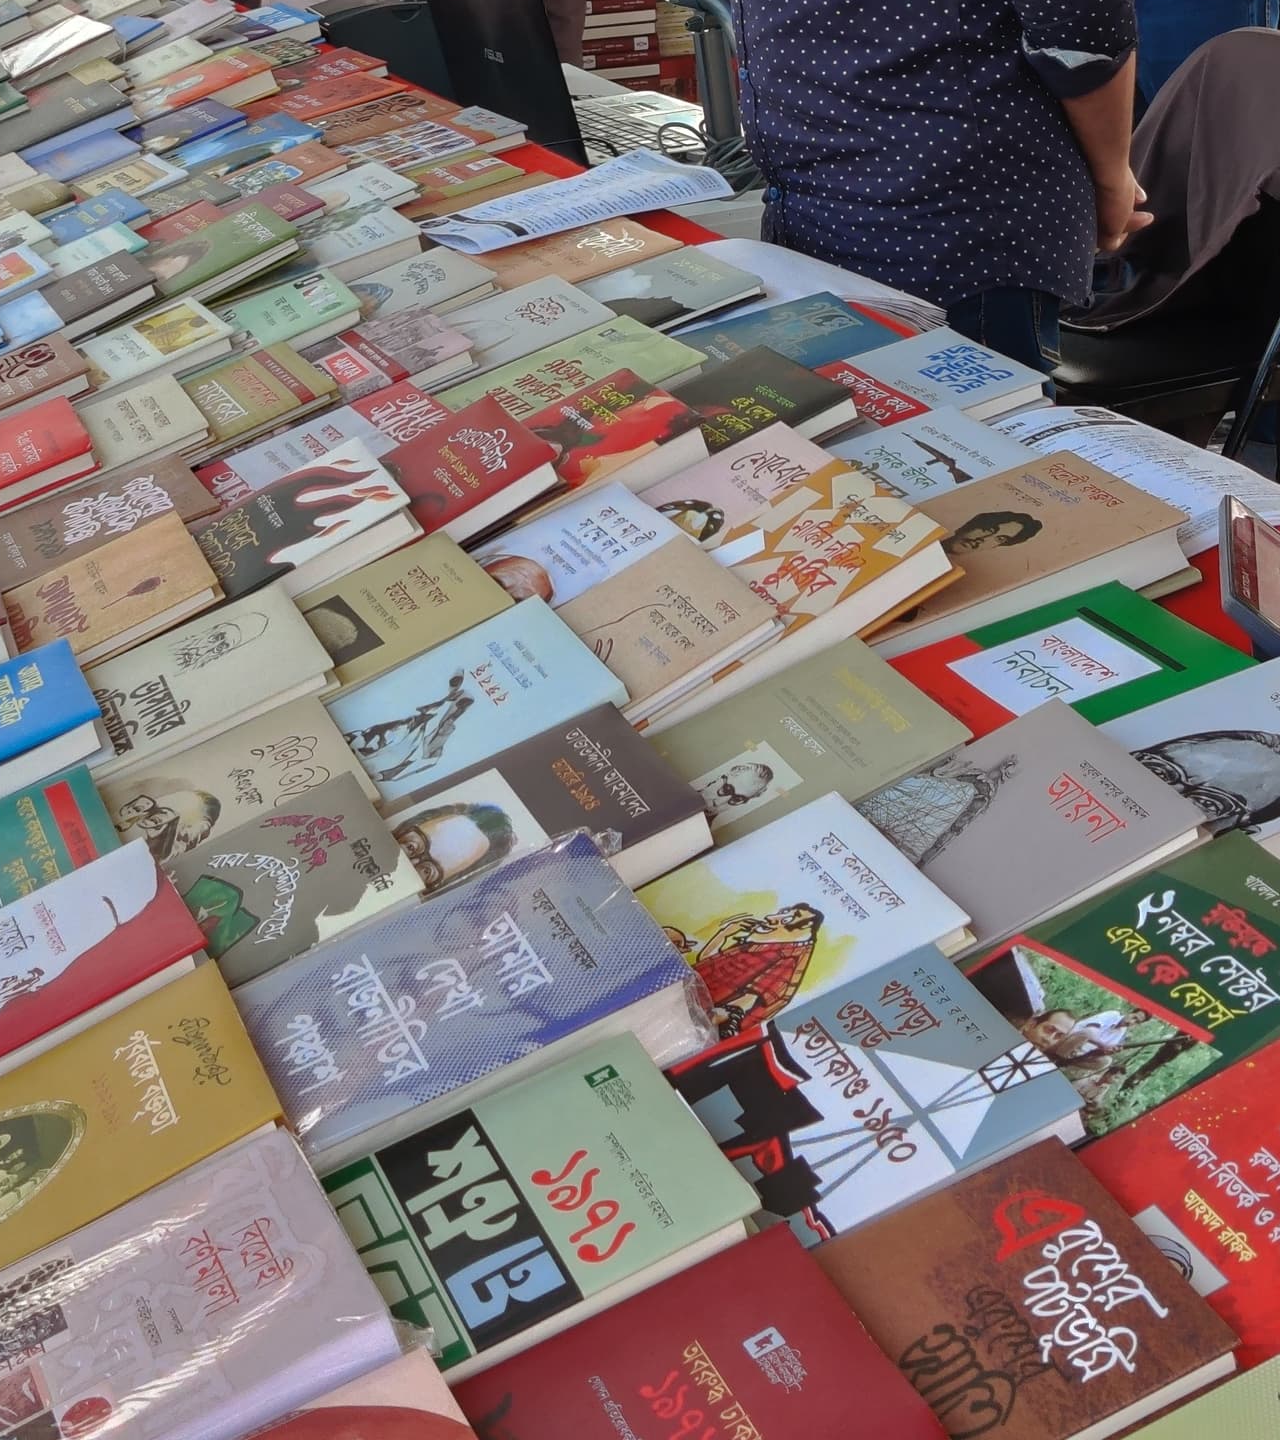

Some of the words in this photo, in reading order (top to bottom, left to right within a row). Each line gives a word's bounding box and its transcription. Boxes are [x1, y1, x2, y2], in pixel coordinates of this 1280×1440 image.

[8, 660, 48, 697] আমার
[993, 631, 1074, 713] নির্বাচন
[1042, 623, 1119, 697] বাংলাদেশে
[129, 675, 191, 739] ভাসানীর
[565, 727, 612, 772] তাজউদ্দীন
[604, 768, 650, 817] আহমদের
[1048, 772, 1126, 843] আয়না
[1079, 760, 1102, 777] আবুল
[1099, 777, 1124, 798] মনসুর
[1122, 797, 1148, 818] আহমদ
[790, 848, 824, 881] আবুল
[818, 871, 844, 895] মনসুর
[840, 893, 870, 920] আহমদ
[812, 831, 849, 856] ফুড
[842, 852, 905, 912] কনফারেন্স
[479, 911, 554, 1008] আমার
[1136, 890, 1176, 929] ২
[1156, 909, 1215, 957] নম্বর
[332, 953, 429, 1086] রাজনীতির
[416, 958, 487, 1022] দেখা
[878, 980, 941, 1037] খাপড়া
[1106, 927, 1151, 963] এবং
[1132, 941, 1187, 1000] কে
[1170, 982, 1248, 1041] ফোর্স
[114, 1030, 161, 1086] পূর্ববঙ্গে
[836, 1000, 907, 1060] ওয়ার্ড
[133, 1078, 180, 1134] বক্তৃতা
[790, 1011, 870, 1099] হত্যাকাণ্ড
[853, 1098, 917, 1163] ১৯৫০
[531, 1150, 636, 1263] ১৯৭১
[1175, 1185, 1229, 1237] আহমদ
[1212, 1220, 1263, 1270] রফিক
[1250, 1205, 1277, 1231] ও
[180, 1229, 240, 1317] বর্ণমালা
[232, 1217, 296, 1289] বিদ্রোহী
[997, 1201, 1168, 1371] একুশের
[1023, 1247, 1137, 1383] পটভূমি
[683, 1340, 733, 1405] অবরুদ্ধ
